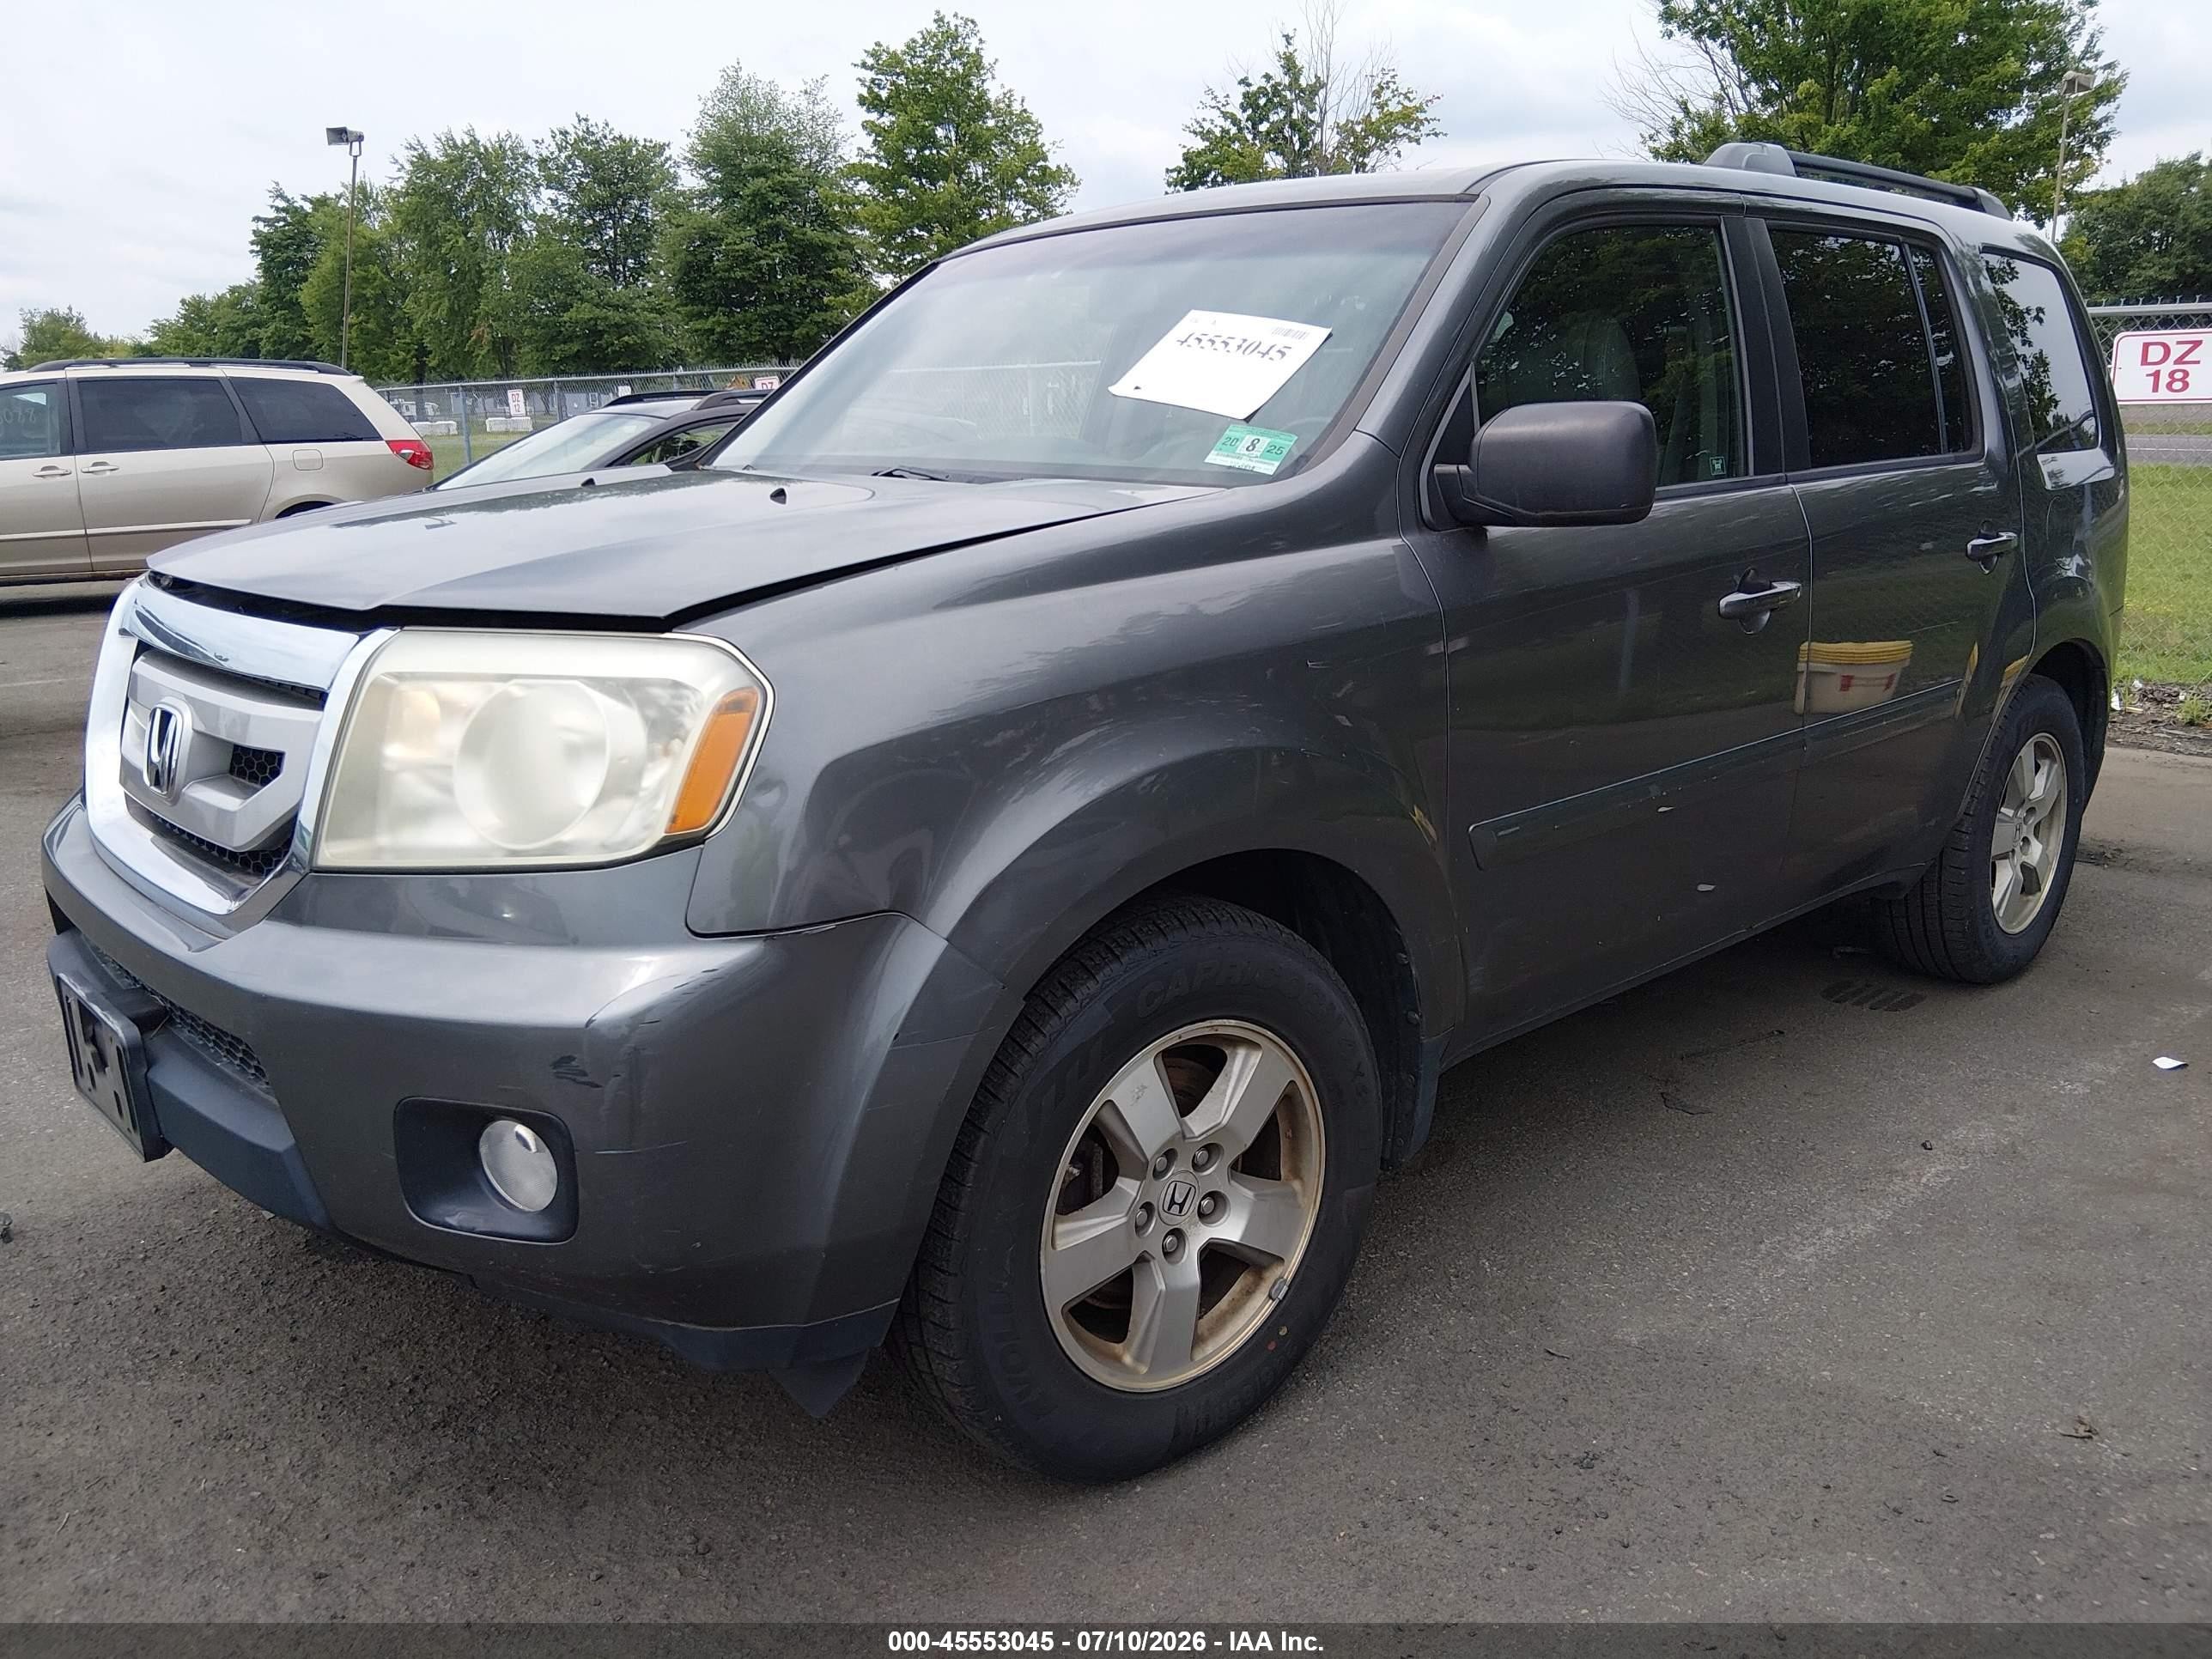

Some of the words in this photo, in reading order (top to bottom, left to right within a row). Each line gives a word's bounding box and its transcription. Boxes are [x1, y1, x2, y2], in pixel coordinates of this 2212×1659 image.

[1176, 332, 1292, 361] 45553045
[2140, 339, 2203, 366] DZ
[2145, 368, 2190, 393] 18
[1222, 436, 1239, 447] 20
[1245, 438, 1261, 453] 8
[1267, 445, 1285, 456] 25
